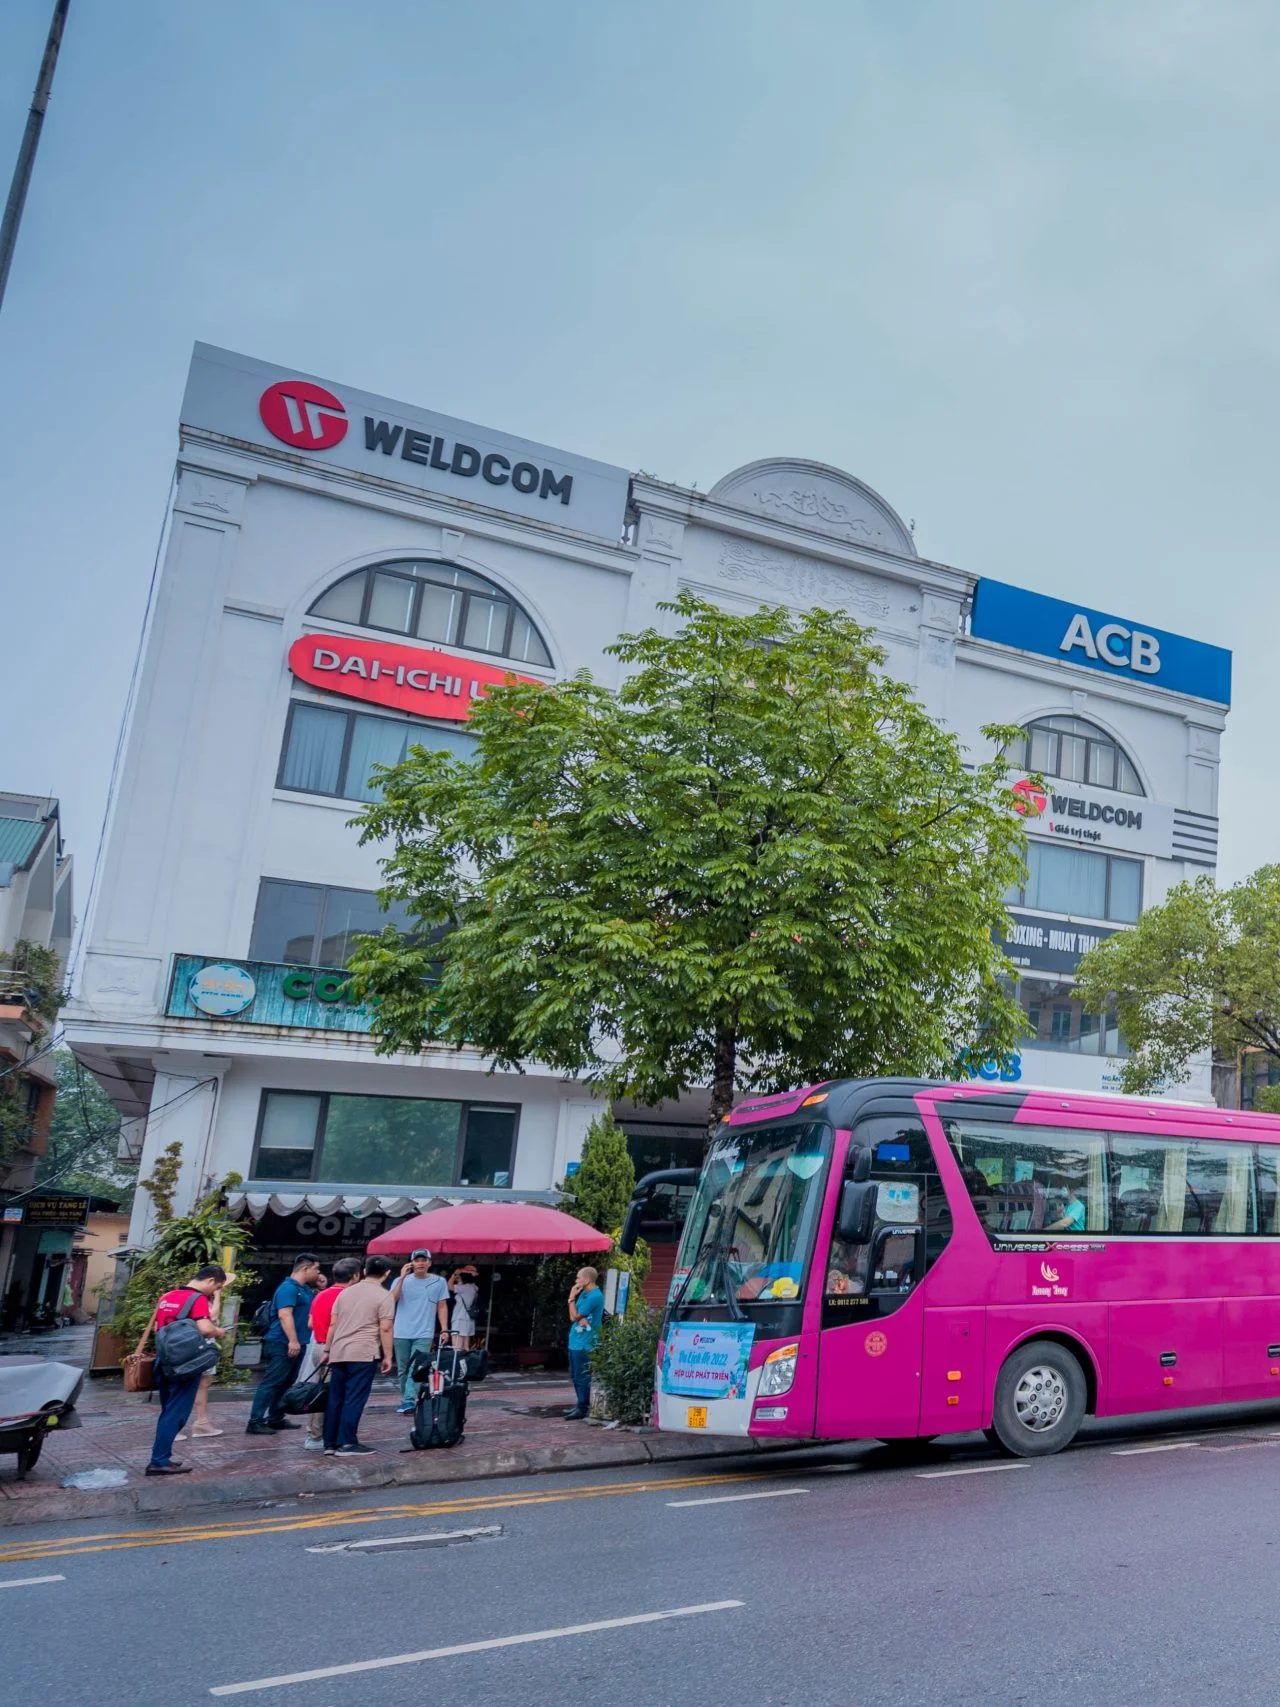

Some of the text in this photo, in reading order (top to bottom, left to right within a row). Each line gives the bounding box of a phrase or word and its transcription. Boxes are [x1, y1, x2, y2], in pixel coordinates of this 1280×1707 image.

[363, 416, 573, 505] WELDCOM
[1059, 614, 1161, 675] ACB
[313, 649, 461, 698] DAI-ICHI
[1051, 794, 1142, 830] WELDCOM
[1054, 824, 1070, 834] Giá
[1071, 825, 1082, 838] trị
[1049, 930, 1076, 952] MUAY
[1078, 934, 1100, 953] THA
